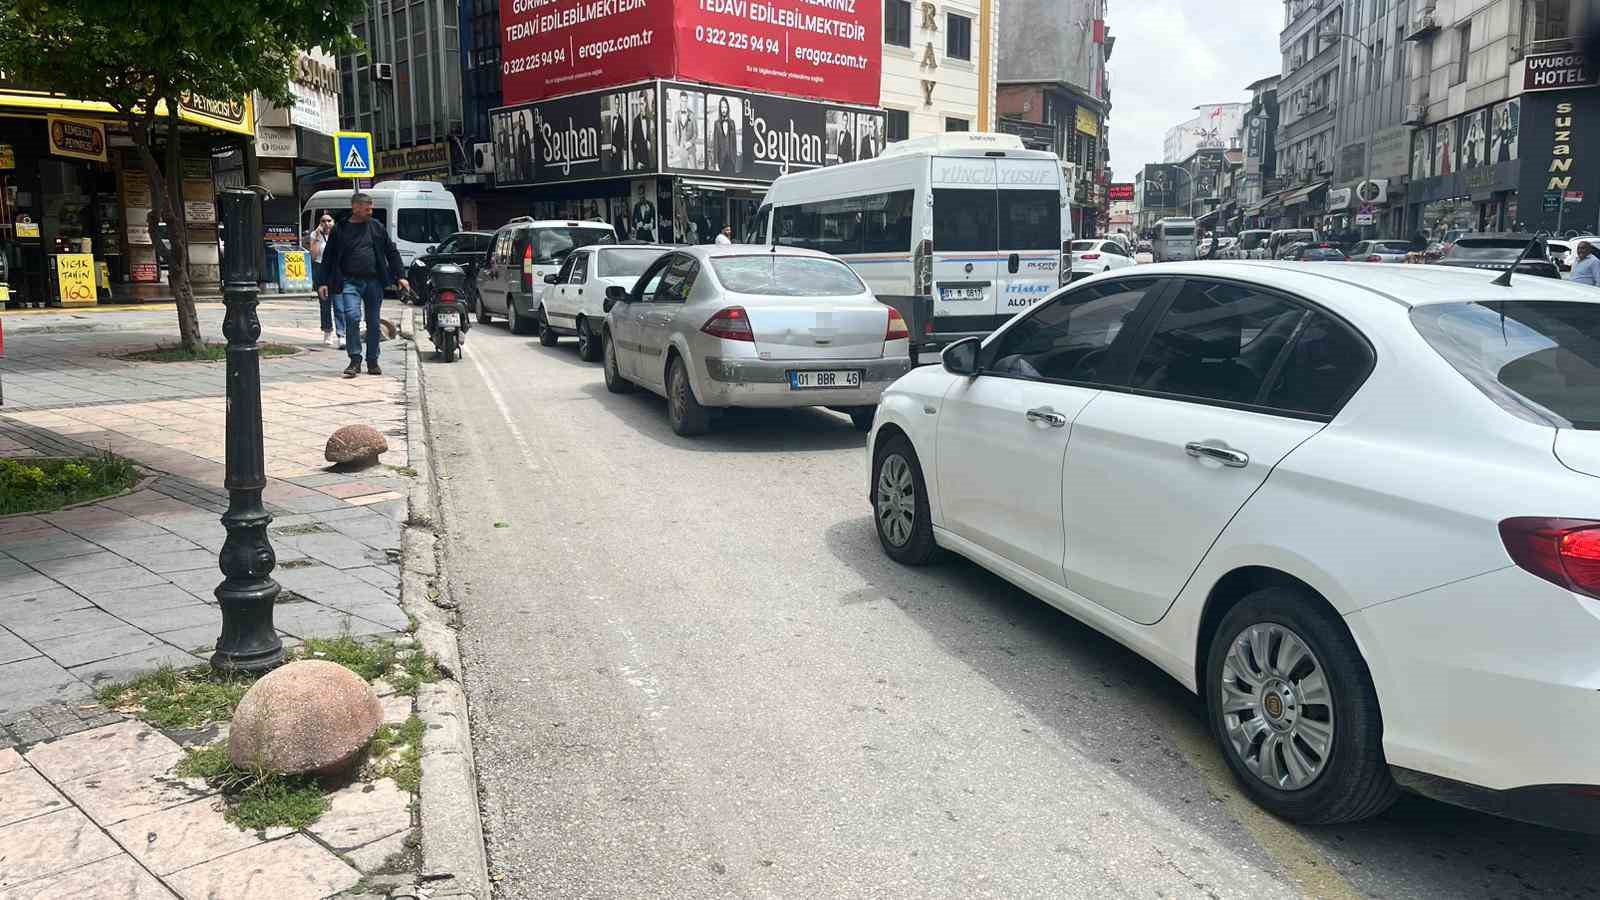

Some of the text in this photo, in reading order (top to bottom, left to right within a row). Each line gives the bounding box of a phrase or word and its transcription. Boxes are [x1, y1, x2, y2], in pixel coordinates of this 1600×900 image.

[506, 14, 539, 42] TEDAVİ
[750, 2, 865, 42] EDİLEBİLMEKTEDİR
[579, 28, 653, 59] eragoz.com.tr
[696, 25, 779, 55] 0 322 225 94 94
[504, 47, 565, 74] 0 322 225 94 94
[795, 44, 867, 69] eragoz.com.tr
[1534, 67, 1586, 85] HOTEL
[543, 116, 598, 176] Seyhan
[743, 98, 822, 175] By Seyhan
[1000, 167, 1050, 183] YUSUF
[287, 265, 302, 277] SU
[1008, 298, 1025, 307] ALO
[799, 372, 858, 385] 01 BBR 46
